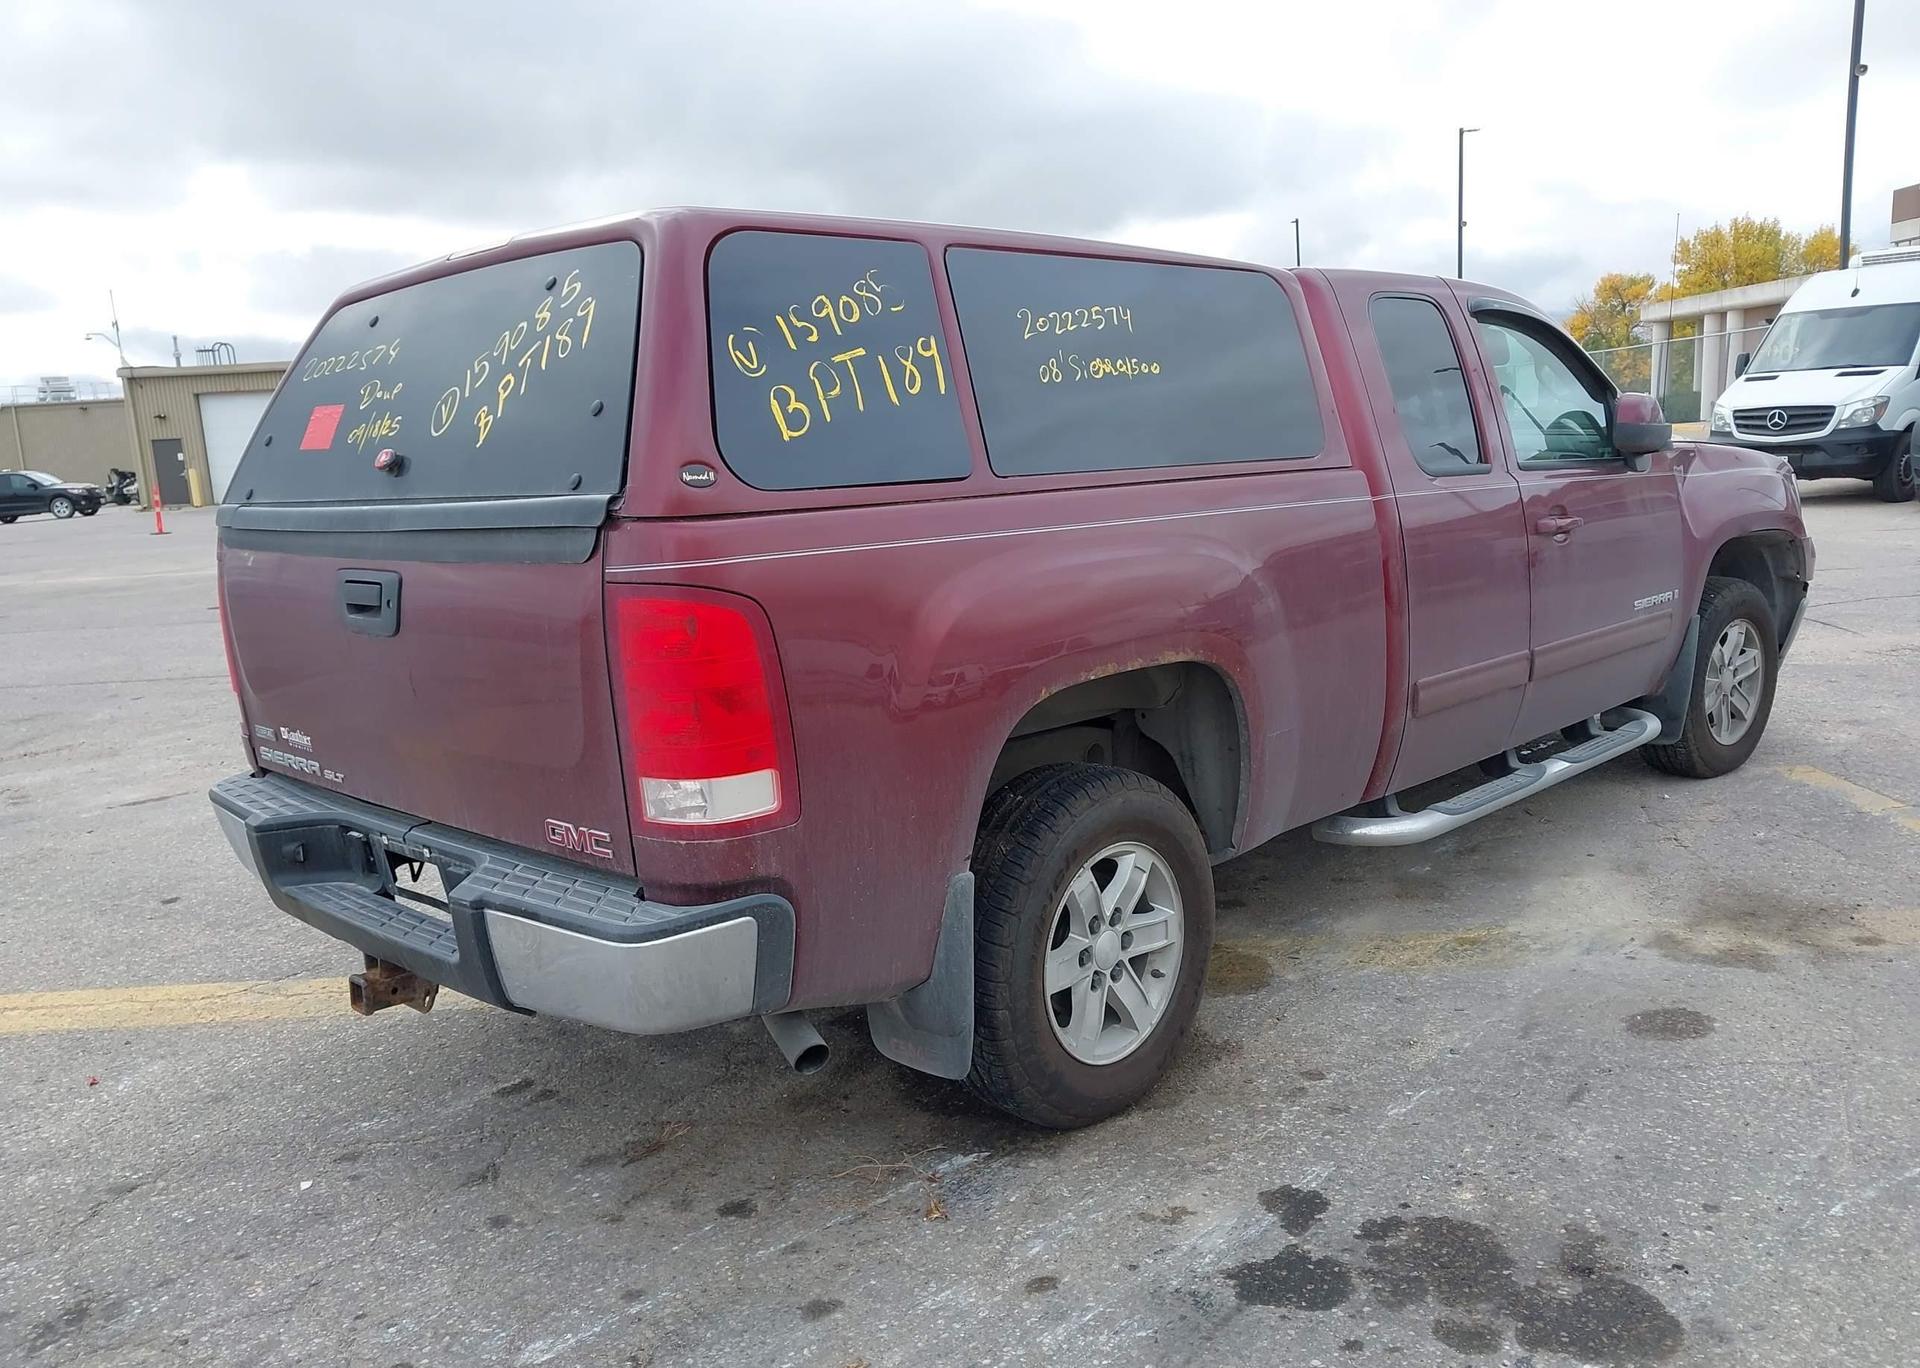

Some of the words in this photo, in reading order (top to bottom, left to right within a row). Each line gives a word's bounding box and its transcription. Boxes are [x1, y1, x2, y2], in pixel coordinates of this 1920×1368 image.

[1016, 305, 1134, 340] 20222574
[769, 334, 946, 442] BPT189
[1634, 591, 1673, 611] SIERRA
[260, 746, 322, 777] SIERRA
[323, 769, 345, 783] SLT
[544, 818, 613, 859] GMC
